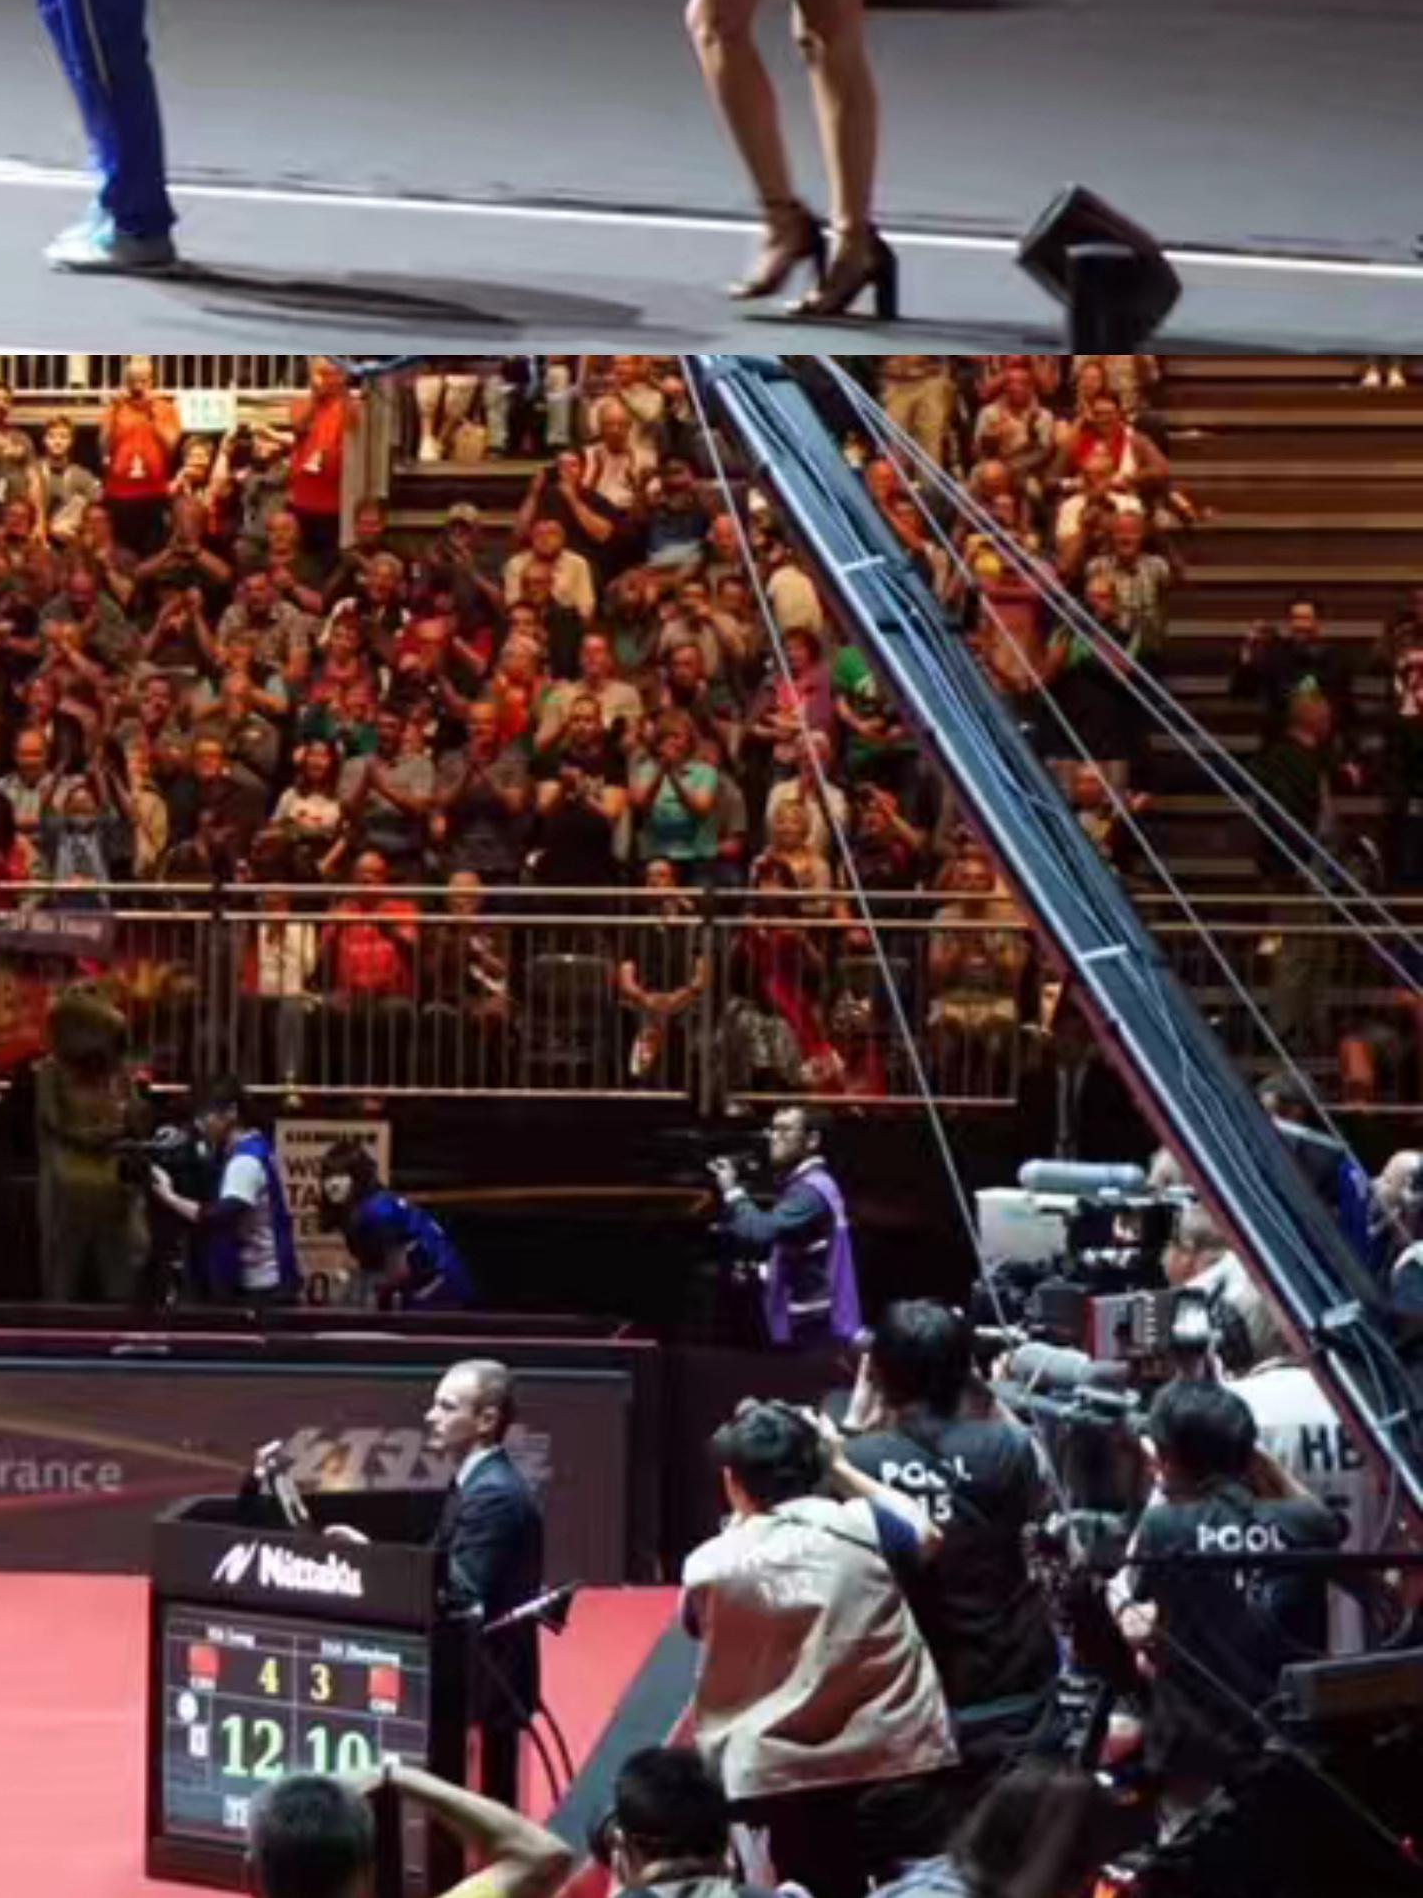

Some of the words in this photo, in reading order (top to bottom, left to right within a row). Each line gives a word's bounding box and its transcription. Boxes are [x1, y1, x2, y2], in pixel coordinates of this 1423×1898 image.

[1196, 1524, 1286, 1552] POOL
[257, 1656, 280, 1695] 4
[309, 1663, 332, 1702] 3
[220, 1714, 285, 1779] 12
[306, 1725, 377, 1777] 10
